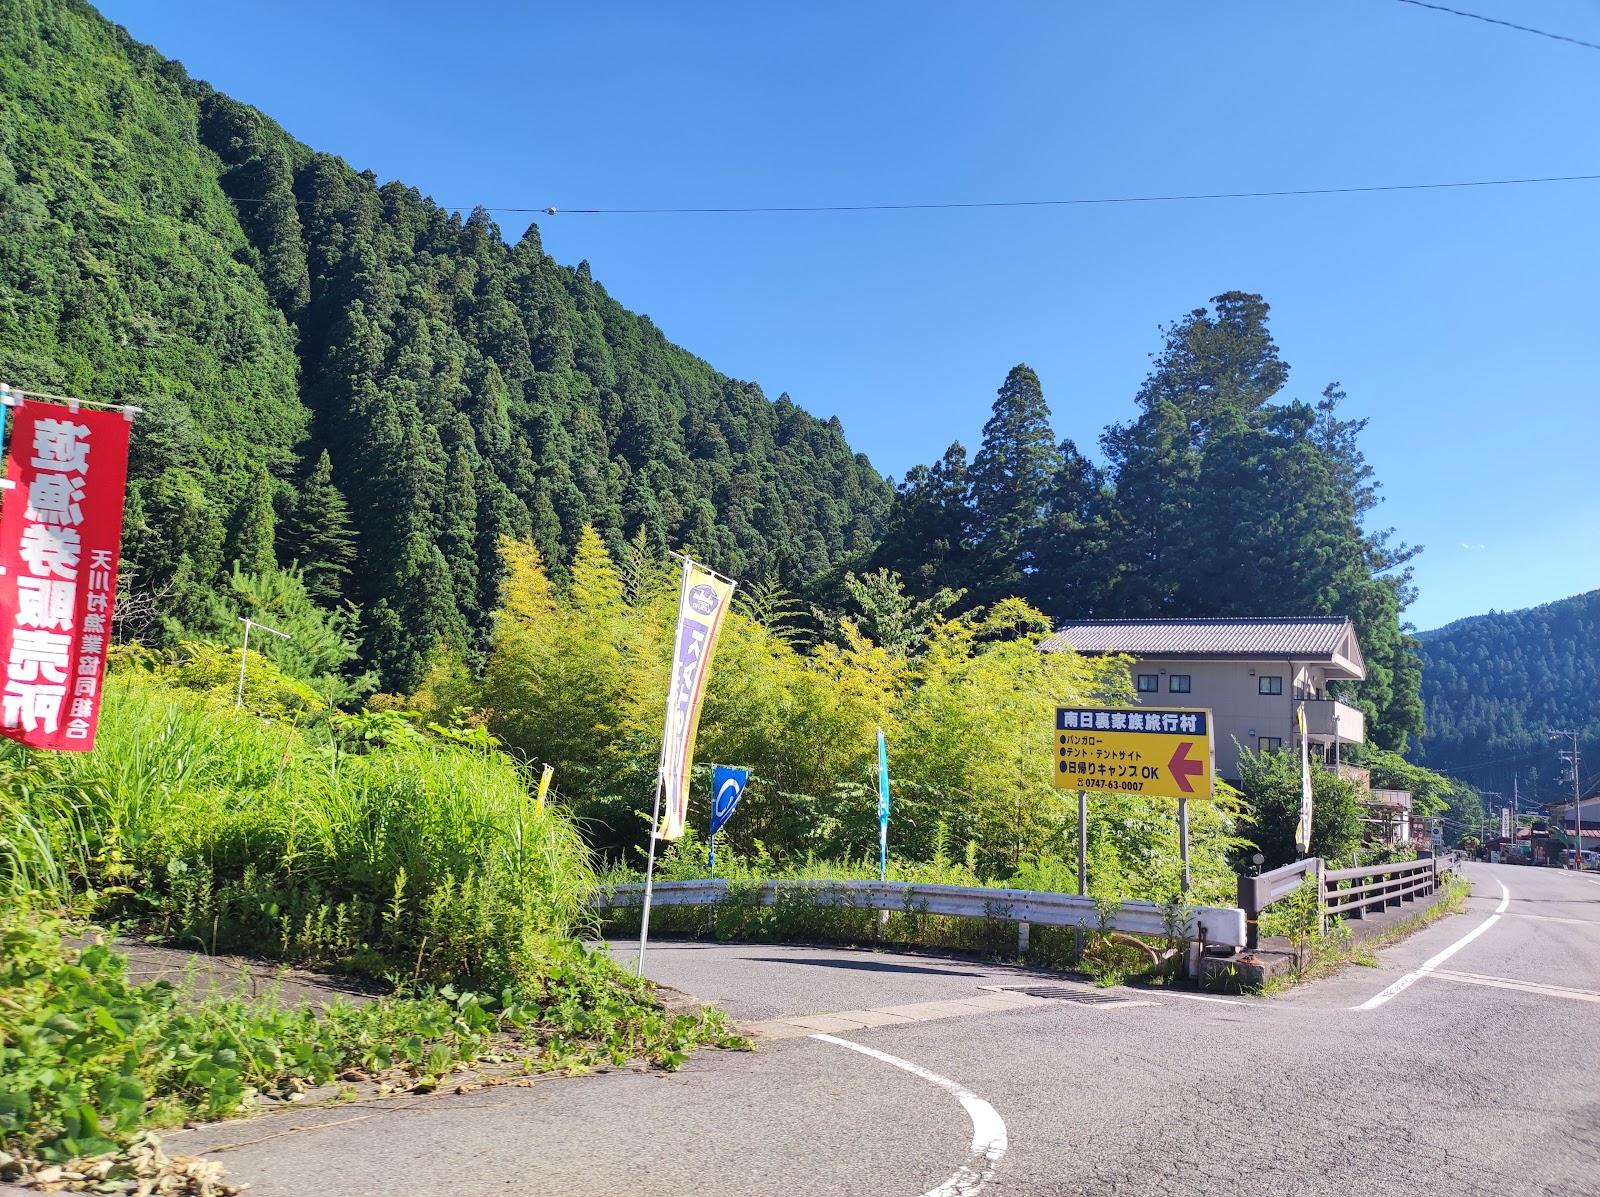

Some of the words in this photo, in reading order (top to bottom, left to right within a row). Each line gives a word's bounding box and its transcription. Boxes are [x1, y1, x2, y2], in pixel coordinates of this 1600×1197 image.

[1064, 711, 1197, 732] 南日裏家族旅行村
[1067, 735, 1103, 746] バンガロー
[1067, 747, 1142, 761] テント・テントサイト
[1141, 766, 1159, 780] OK
[1085, 778, 1144, 791] 0747-63-0007
